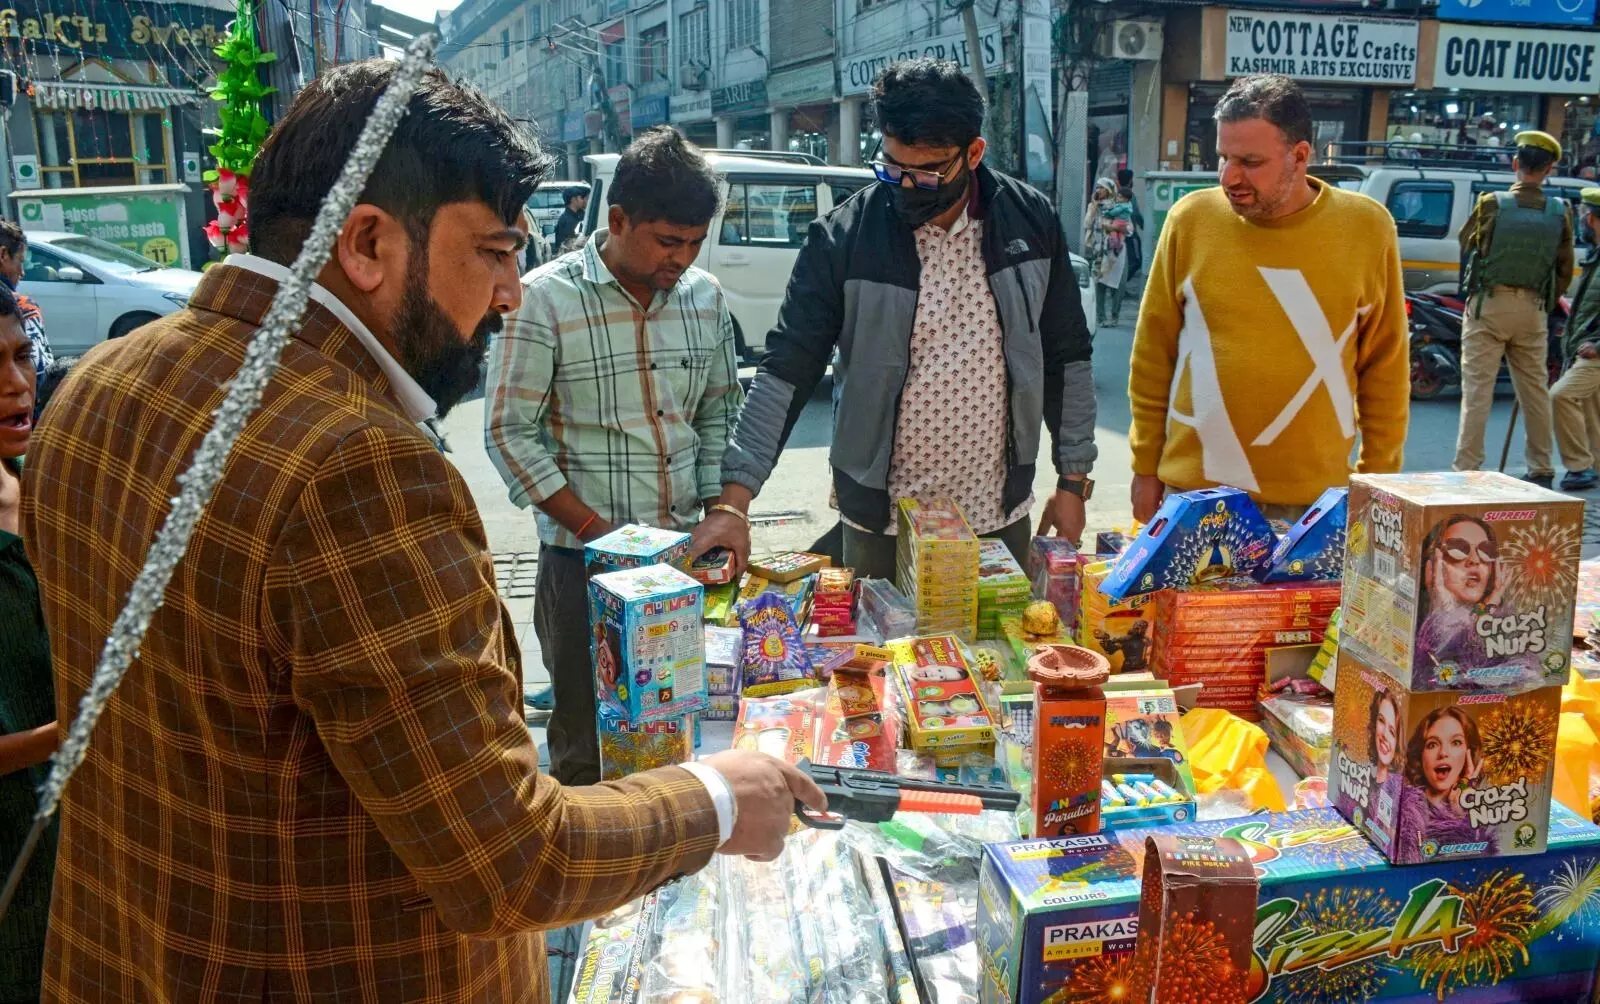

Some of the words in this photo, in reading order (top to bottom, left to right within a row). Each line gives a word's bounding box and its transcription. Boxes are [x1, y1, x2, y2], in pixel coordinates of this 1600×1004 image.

[1229, 16, 1251, 33] NEW
[1251, 19, 1359, 59] COTTAGE
[1363, 41, 1416, 62] Crafts
[1230, 56, 1296, 76] KASHMIR
[1300, 59, 1336, 77] ARTS
[1339, 61, 1412, 80] EXCLUSIVE
[1445, 36, 1511, 77] COAT
[1513, 40, 1594, 82] HOUSE
[131, 221, 166, 237] sasta
[151, 248, 168, 263] 11
[1483, 510, 1537, 521] SUPREME
[635, 593, 697, 617] VADIVEL
[1476, 604, 1546, 637] Crazy
[865, 651, 887, 659] pieces
[1484, 629, 1546, 659] Nuts
[980, 730, 991, 738] 10
[1459, 776, 1528, 809] Crazy
[1043, 804, 1096, 828] Paradise
[1467, 799, 1529, 830] Nuts
[1010, 836, 1102, 853] PRAKASH
[1439, 842, 1489, 854] SUPREME
[1043, 892, 1108, 906] COLOURS
[1050, 920, 1139, 943] PRAKAS
[1047, 946, 1100, 956] Amazing
